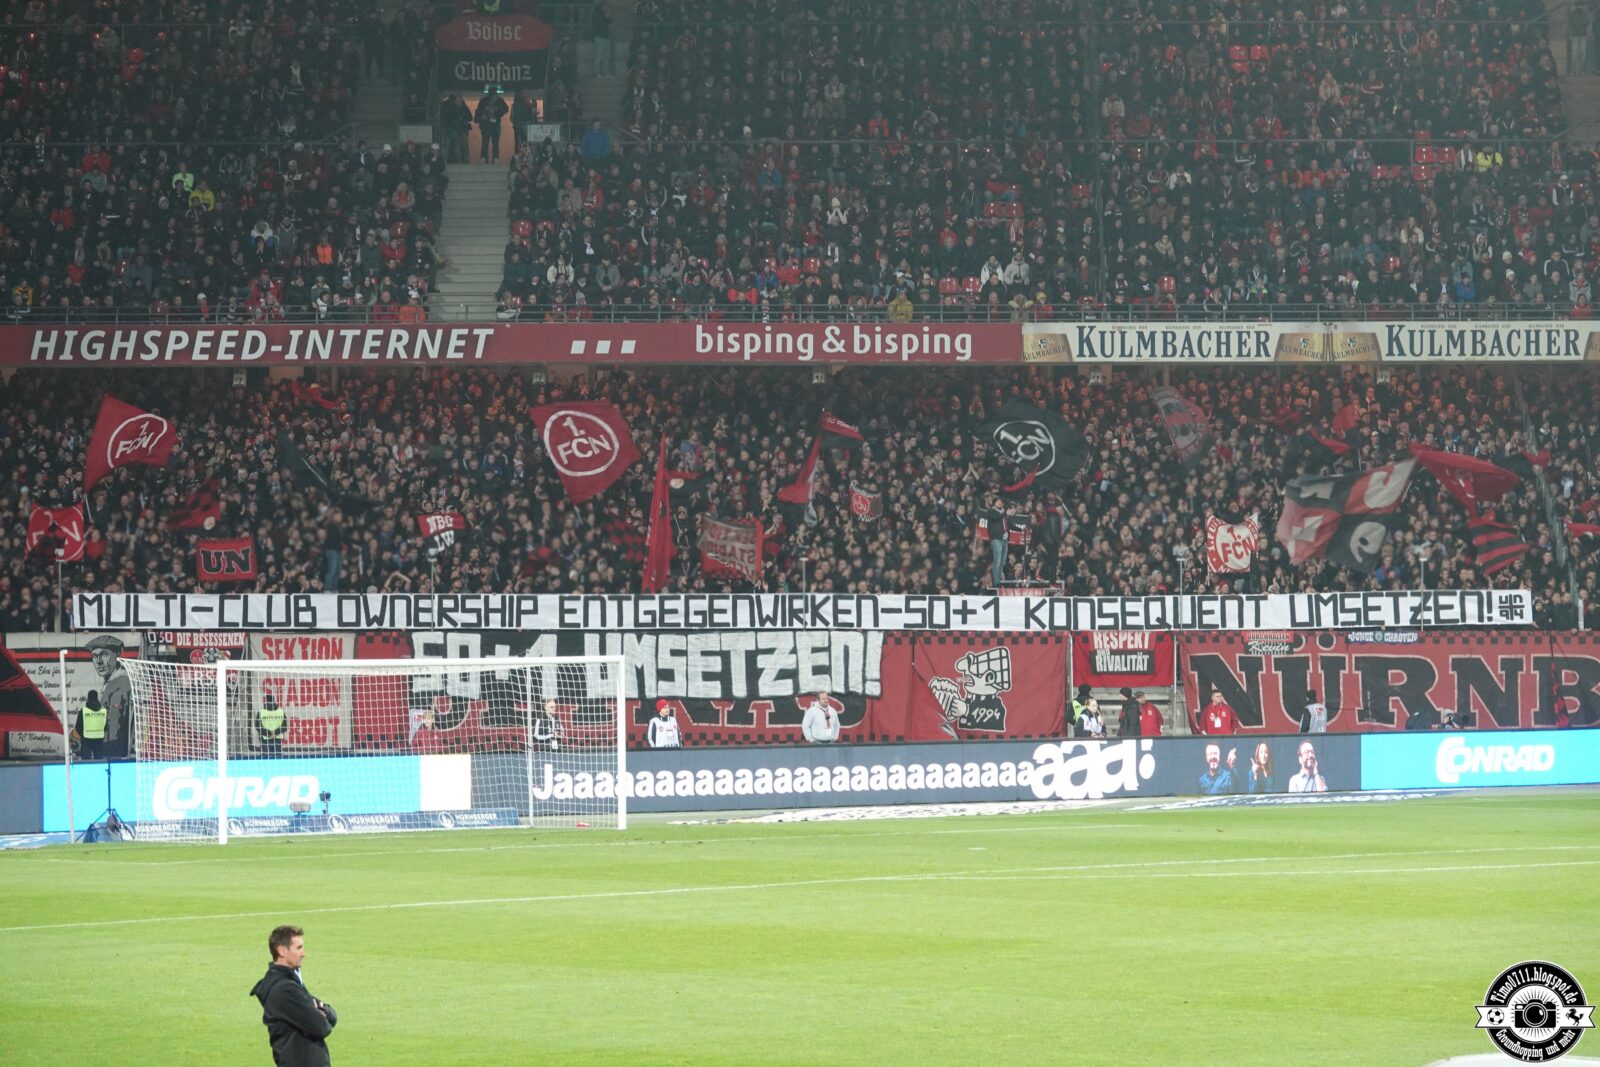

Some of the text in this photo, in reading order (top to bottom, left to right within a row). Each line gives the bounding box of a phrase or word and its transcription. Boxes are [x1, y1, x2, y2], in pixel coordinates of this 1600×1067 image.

[466, 20, 523, 42] Böhse
[454, 60, 533, 83] Clubfanz
[30, 328, 495, 361] HIGHSPEED-INTERNET
[695, 324, 815, 360] bisping
[853, 325, 973, 360] bisping
[1075, 325, 1272, 358] KULMBACHER
[1384, 324, 1581, 357] KULMBACHER
[115, 432, 155, 459] FCN
[556, 434, 612, 465] FCN
[200, 546, 252, 574] UN
[1220, 536, 1250, 563] FCN
[78, 593, 317, 628] MULTI-CLUB
[337, 594, 538, 629] OWNERSHIP
[1024, 596, 1271, 630] KONSEQUENT
[1290, 590, 1494, 629] UMSETZEN!
[176, 631, 246, 647] DIE BESESSENEN
[1092, 631, 1151, 650] RESPEKT
[583, 630, 884, 699] UMSETZEN!
[1095, 651, 1150, 672] RIVALITÄT
[971, 706, 1001, 723] 1994
[1436, 736, 1555, 784] CONRAD
